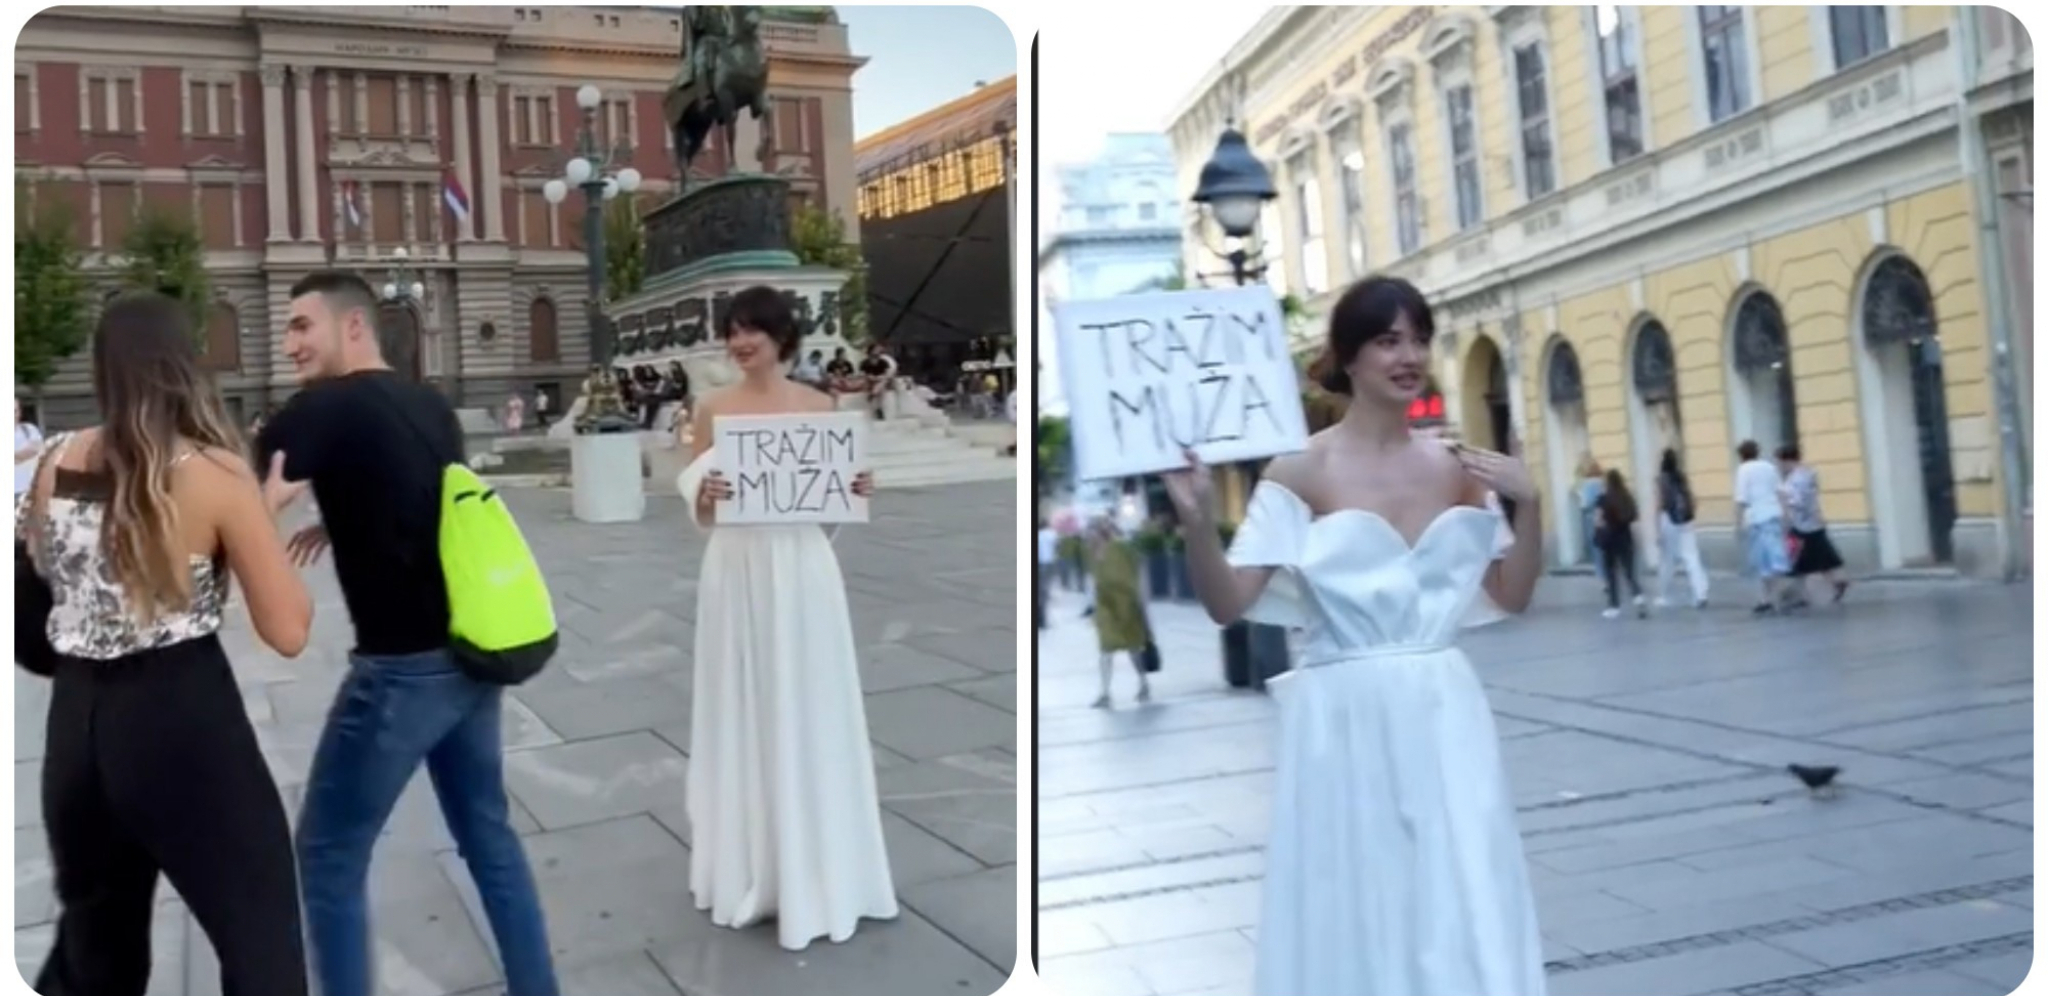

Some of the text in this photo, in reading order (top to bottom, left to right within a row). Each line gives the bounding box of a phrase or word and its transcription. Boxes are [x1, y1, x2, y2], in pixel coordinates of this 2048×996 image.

[1079, 305, 1276, 378] TRAŽIM
[1108, 369, 1286, 457] MUŽA
[726, 423, 854, 466] TRAŽIM
[738, 466, 851, 515] MUŽA
